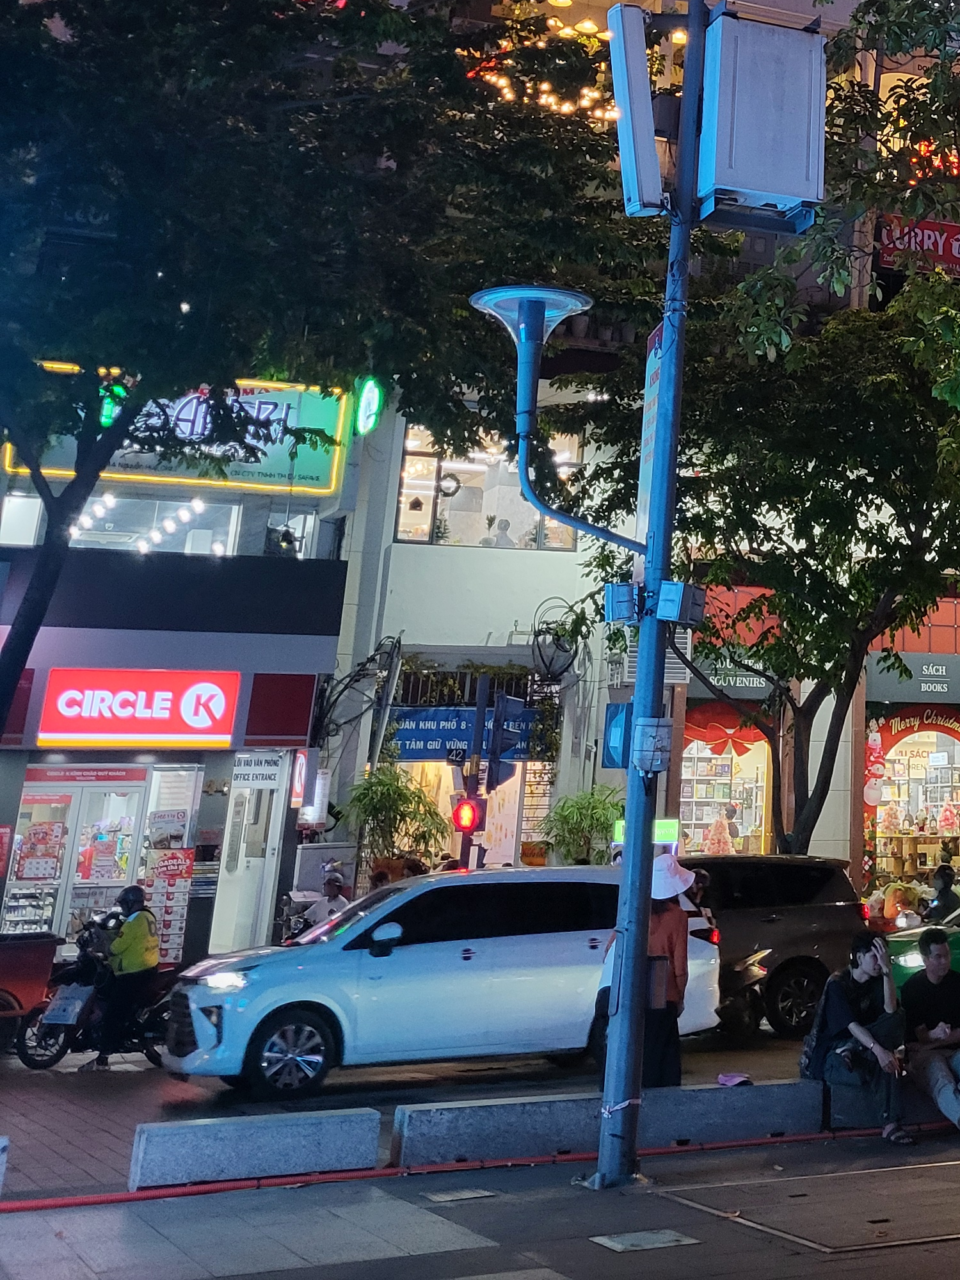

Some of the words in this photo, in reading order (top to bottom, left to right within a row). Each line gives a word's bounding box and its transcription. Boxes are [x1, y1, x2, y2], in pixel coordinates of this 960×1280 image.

[881, 226, 948, 256] CURRY
[922, 663, 946, 675] SÁCH
[709, 676, 766, 687] SOUVENIRS
[921, 683, 948, 692] BOOKS
[57, 690, 173, 718] CIRCLE
[419, 721, 438, 730] KHU
[460, 721, 467, 730] 8
[889, 715, 920, 735] Merry
[405, 738, 424, 749] TÂM
[449, 749, 463, 762] 42
[233, 773, 250, 781] OFFICE
[252, 773, 277, 781] ENTRANCE
